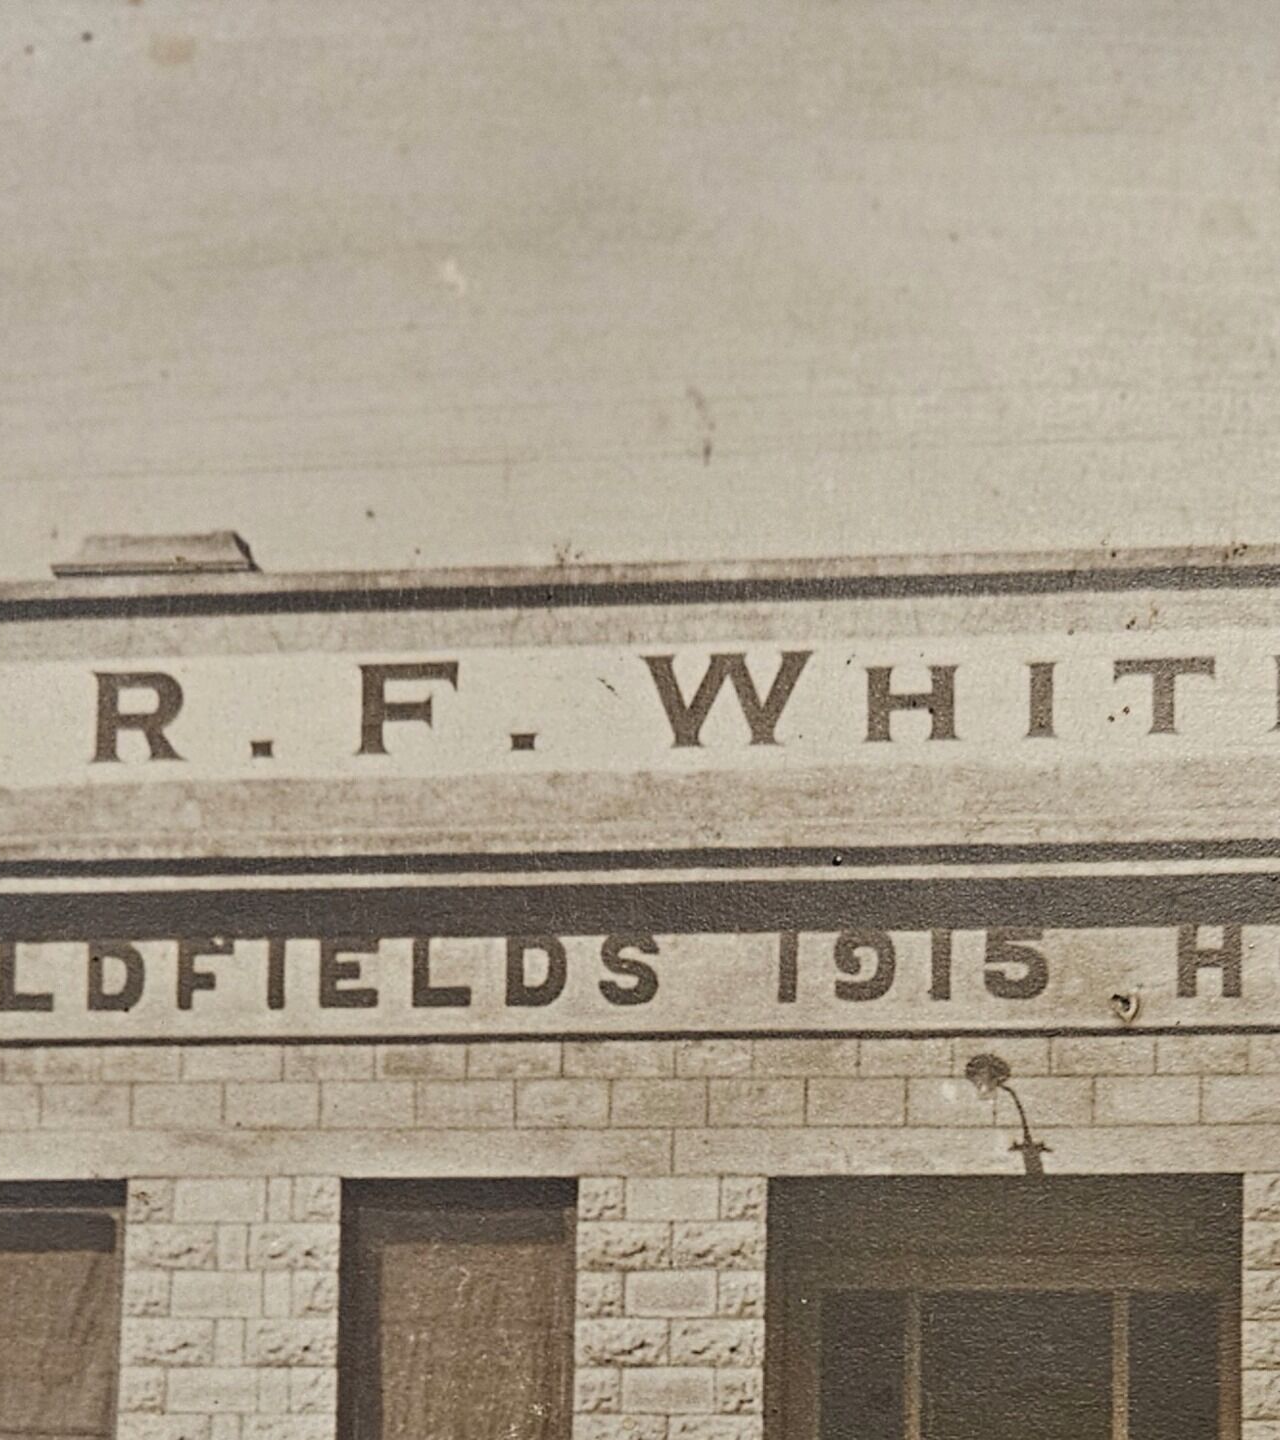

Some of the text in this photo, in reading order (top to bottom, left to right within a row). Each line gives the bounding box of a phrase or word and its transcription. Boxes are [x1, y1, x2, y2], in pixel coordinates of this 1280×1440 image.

[89, 671, 274, 763] R.
[355, 660, 537, 755] F.
[777, 927, 1050, 1003] 1915
